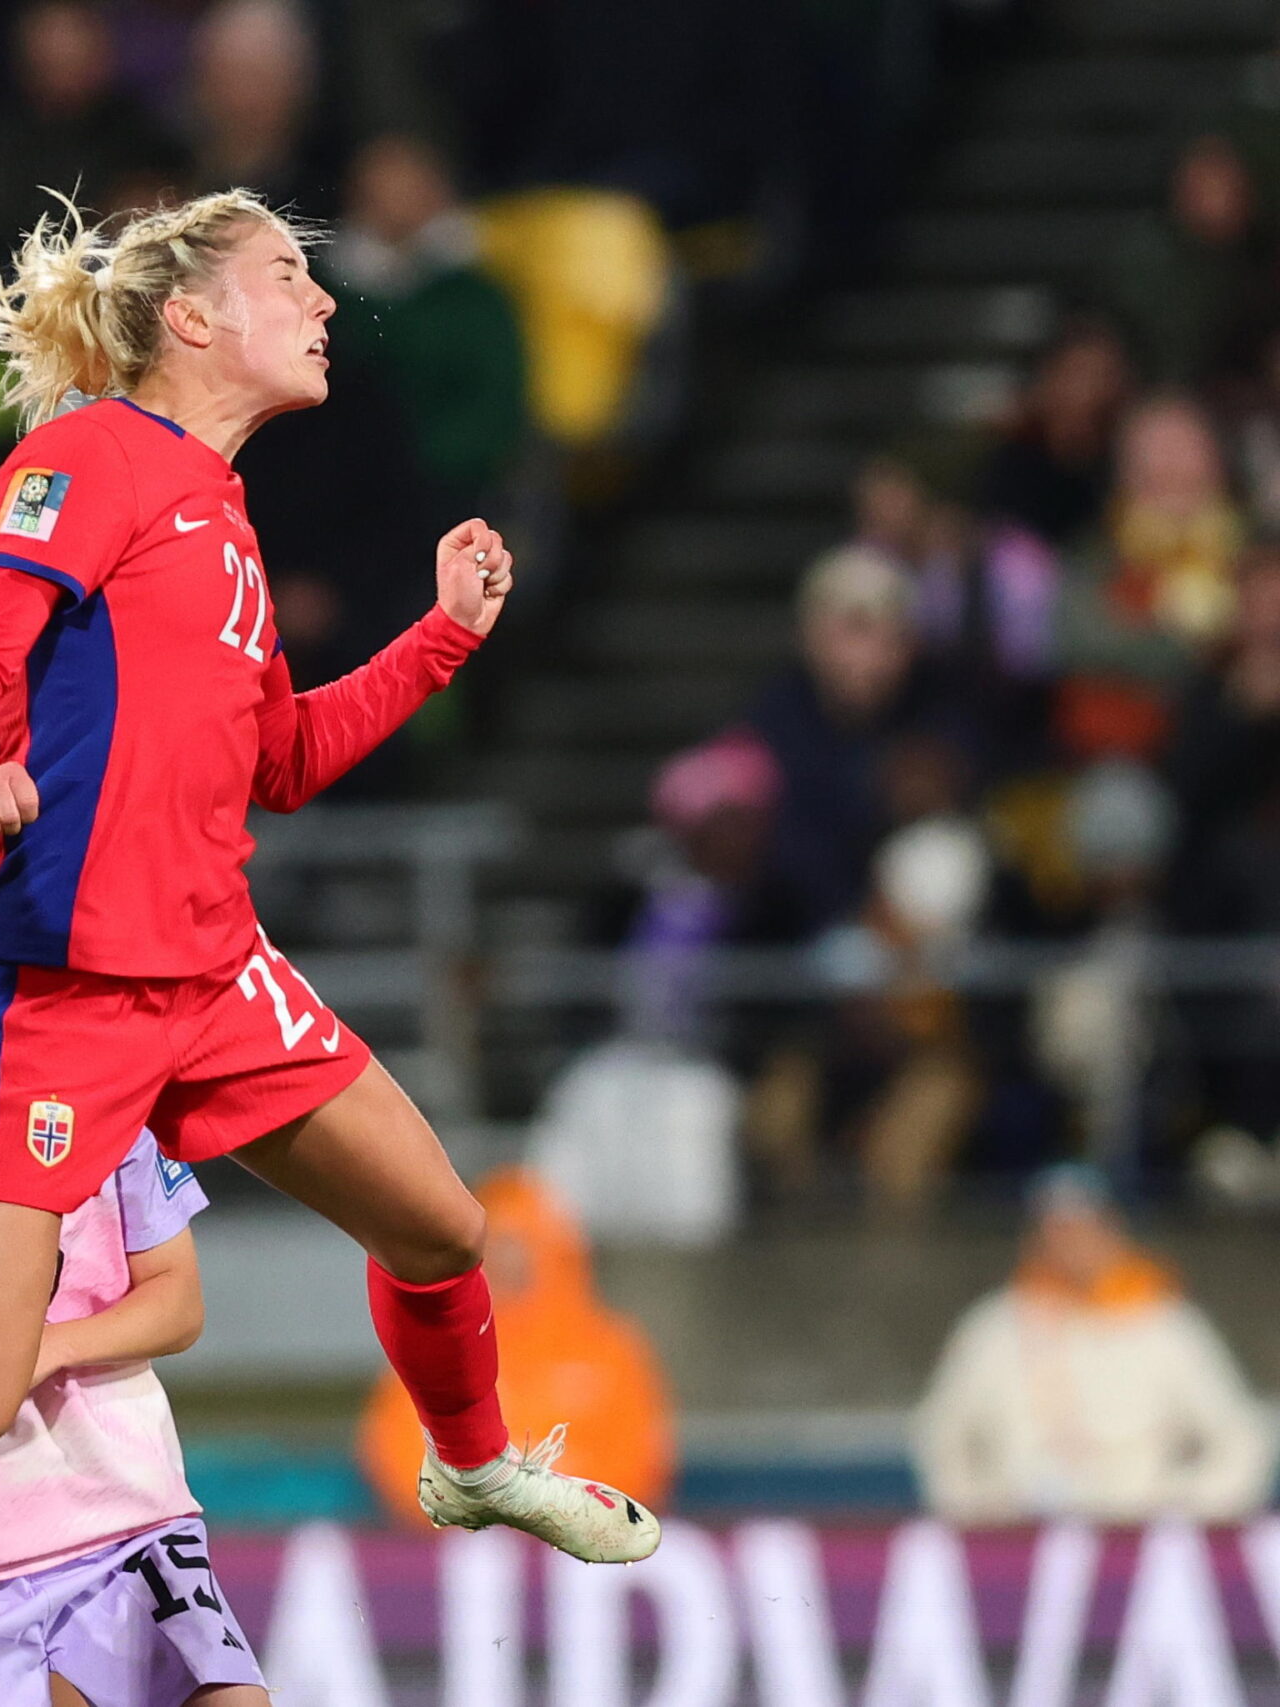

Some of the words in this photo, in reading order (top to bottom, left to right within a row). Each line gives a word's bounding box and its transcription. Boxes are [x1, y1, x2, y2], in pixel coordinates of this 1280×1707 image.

[218, 541, 266, 664] 22
[122, 1533, 223, 1624] 15
[265, 1516, 1280, 1707] AIRWA
